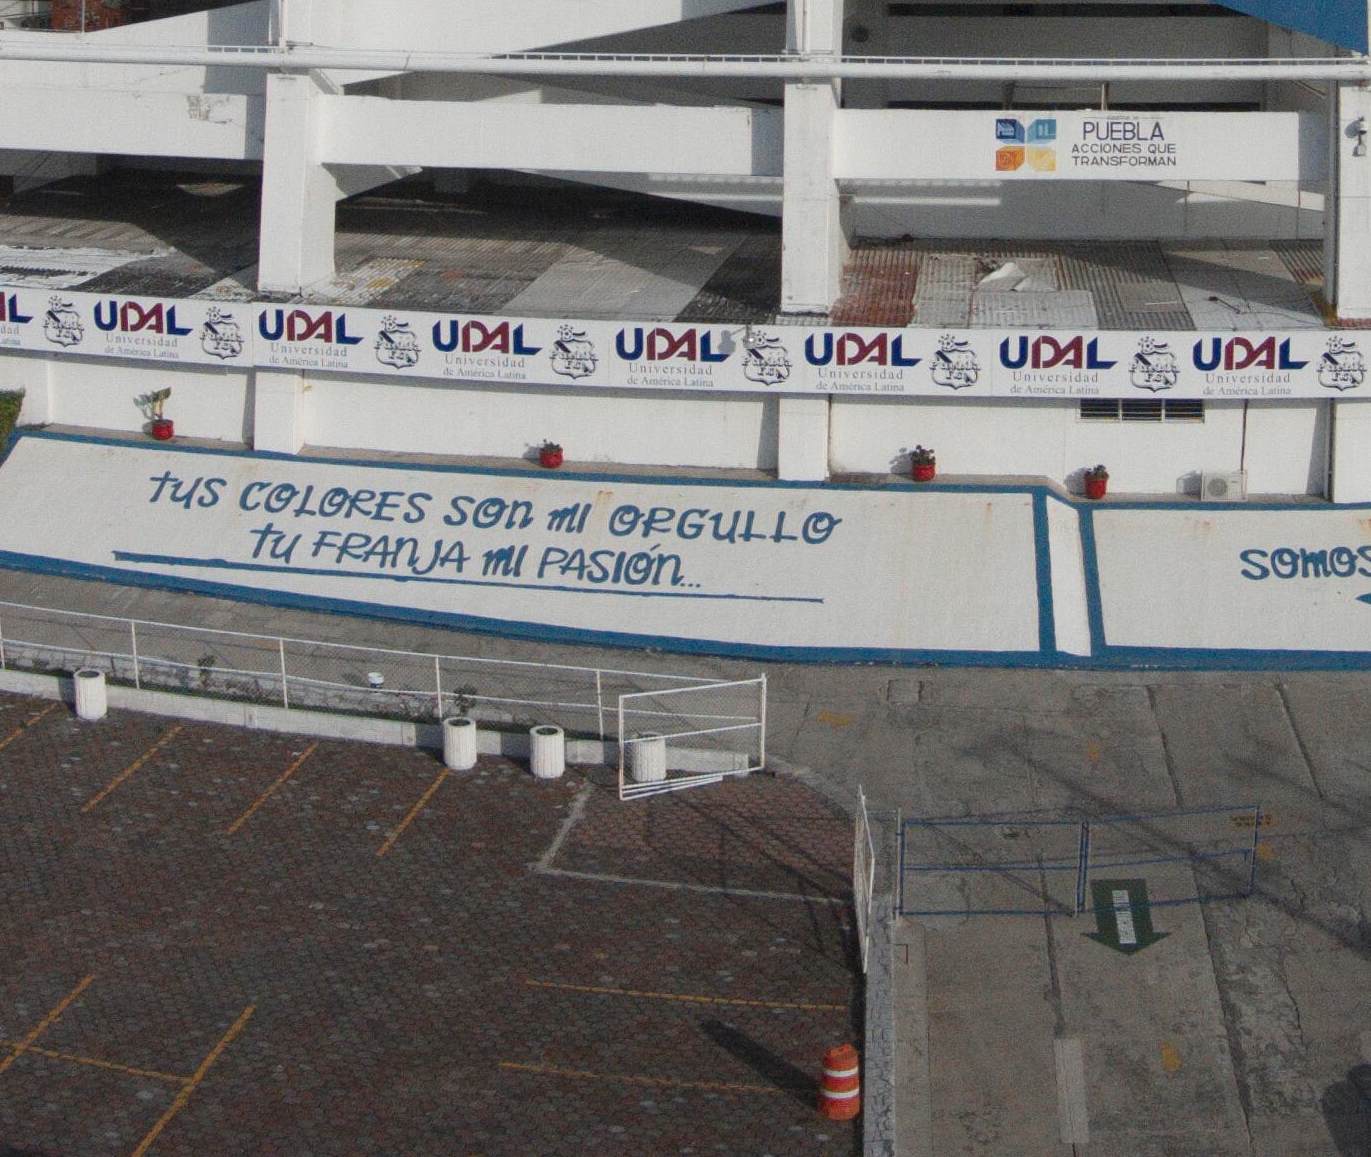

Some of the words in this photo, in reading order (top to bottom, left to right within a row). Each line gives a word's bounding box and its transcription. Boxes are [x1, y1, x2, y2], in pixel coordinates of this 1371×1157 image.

[1083, 121, 1164, 141] PUEBLA
[1072, 144, 1142, 154] ACCIONES
[1148, 144, 1176, 154] QUE
[1072, 156, 1176, 166] TRANSFORMAN
[93, 296, 193, 336] UDAL
[259, 309, 364, 345] UDAL
[106, 332, 178, 347] Universidad
[432, 319, 543, 356] UDAL
[615, 327, 730, 362] UDAL
[270, 343, 347, 357] Universidad
[804, 332, 923, 367] UDAL
[999, 335, 1118, 370] UDAL
[1193, 336, 1310, 371] UDAL
[269, 355, 280, 365] de
[281, 356, 318, 367] América
[321, 358, 348, 369] Latina
[444, 354, 525, 368] Universidad
[443, 367, 454, 376] de
[456, 367, 494, 378] América
[497, 369, 526, 379] Latina
[629, 361, 713, 376] Universidad
[818, 366, 904, 380] Universidad
[627, 375, 638, 385] de
[640, 375, 680, 386] América
[683, 377, 713, 387] Latina
[1013, 371, 1098, 384] Universidad
[1205, 372, 1290, 385] Universidad
[816, 381, 828, 390] de
[830, 381, 870, 391] América
[874, 382, 904, 392] Latina
[1010, 385, 1021, 395] de
[1024, 385, 1065, 395] América
[1068, 385, 1099, 395] Latina
[1203, 386, 1215, 396] de
[1217, 386, 1257, 396] América
[1260, 385, 1291, 395] Latina
[239, 481, 430, 524] COLORES
[609, 504, 842, 544] ORGULLO
[311, 530, 470, 575] FRANJA
